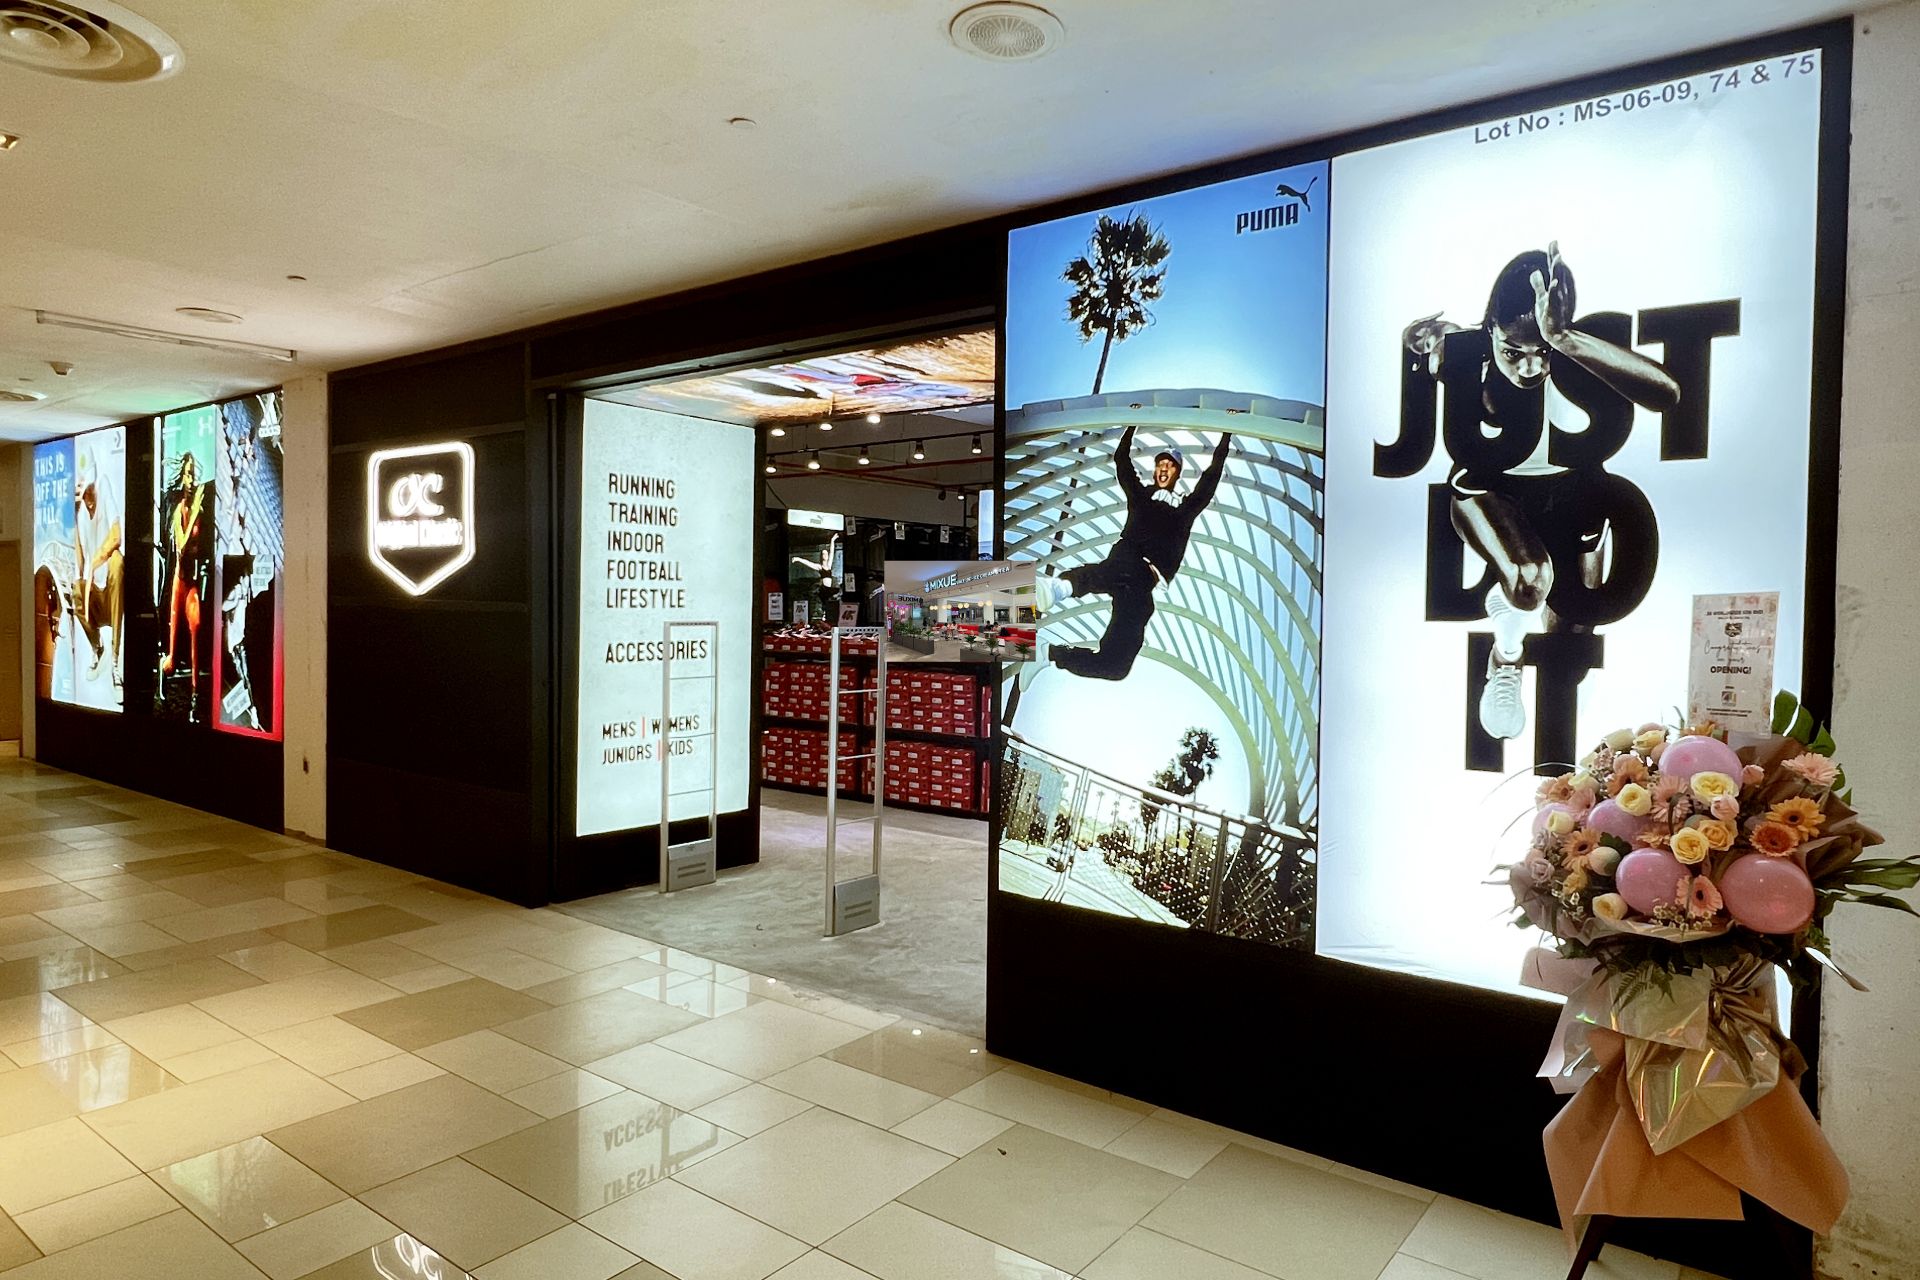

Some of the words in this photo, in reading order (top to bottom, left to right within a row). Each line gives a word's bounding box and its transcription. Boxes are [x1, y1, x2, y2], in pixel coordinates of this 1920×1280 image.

[1473, 120, 1510, 144] Lot
[1517, 114, 1550, 135] No
[1573, 80, 1700, 123] MS-06-09,
[1709, 70, 1741, 93] 74
[1750, 63, 1770, 83] &
[1782, 53, 1815, 79] 75
[1236, 203, 1299, 235] PUMA
[1372, 297, 1741, 478] JUST
[34, 454, 54, 477] THIS
[56, 452, 65, 473] IS
[36, 481, 50, 501] OFF
[52, 478, 68, 499] THE
[608, 473, 675, 499] RUNNING
[608, 501, 679, 527] TRAINING
[607, 530, 664, 553] INDOOR
[1424, 472, 1659, 626] DO
[607, 559, 683, 581] FOOTBALL
[929, 573, 957, 591] MIXUE
[606, 588, 686, 609] LIFESTYLE
[1710, 666, 1752, 675] OPENING!
[1465, 631, 1605, 776] IT
[602, 720, 637, 740] MENS
[651, 714, 700, 734] WMENS
[602, 744, 652, 765] JUNIORS
[667, 740, 693, 757] KIDS
